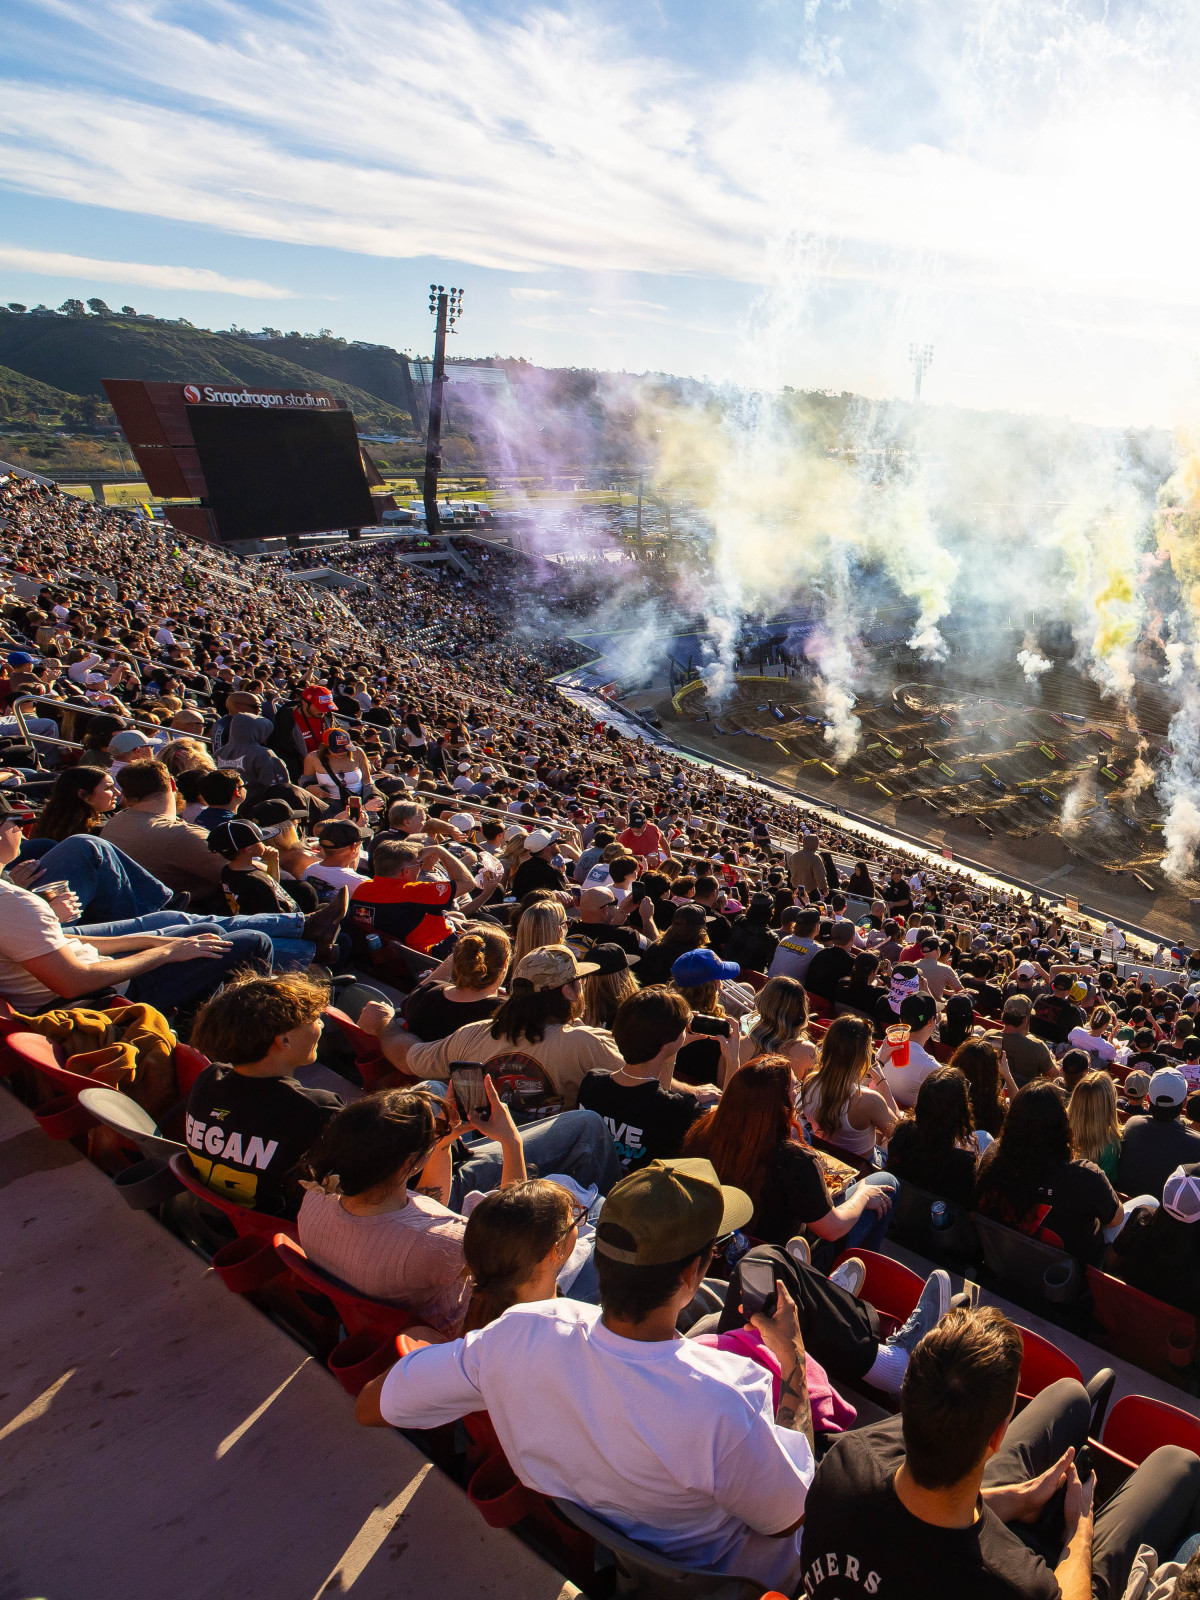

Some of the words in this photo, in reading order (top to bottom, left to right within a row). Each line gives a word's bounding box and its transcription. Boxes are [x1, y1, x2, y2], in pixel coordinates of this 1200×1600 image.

[203, 387, 284, 408] Snapdragon
[285, 393, 331, 407] stadium
[186, 1113, 279, 1171] EEGAN
[803, 1552, 883, 1598] THERS
